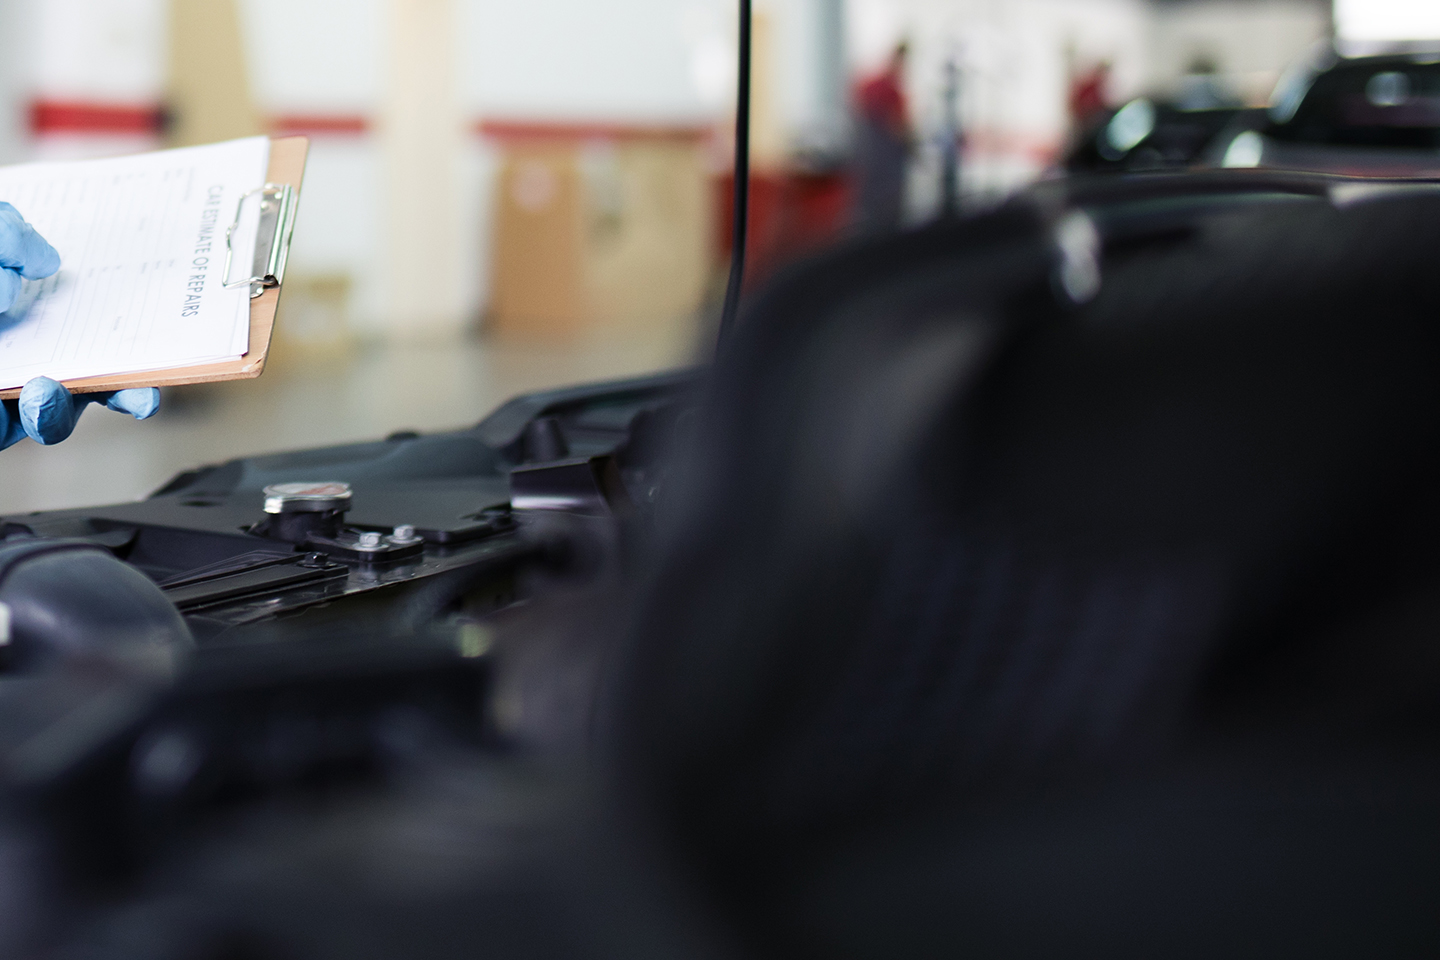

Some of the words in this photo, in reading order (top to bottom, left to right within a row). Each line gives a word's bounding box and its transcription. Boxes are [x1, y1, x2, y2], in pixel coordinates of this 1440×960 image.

[205, 185, 223, 207] CAR
[195, 208, 219, 254] ESTIMATE
[191, 256, 209, 271] OF
[181, 274, 206, 318] REPAIRS
